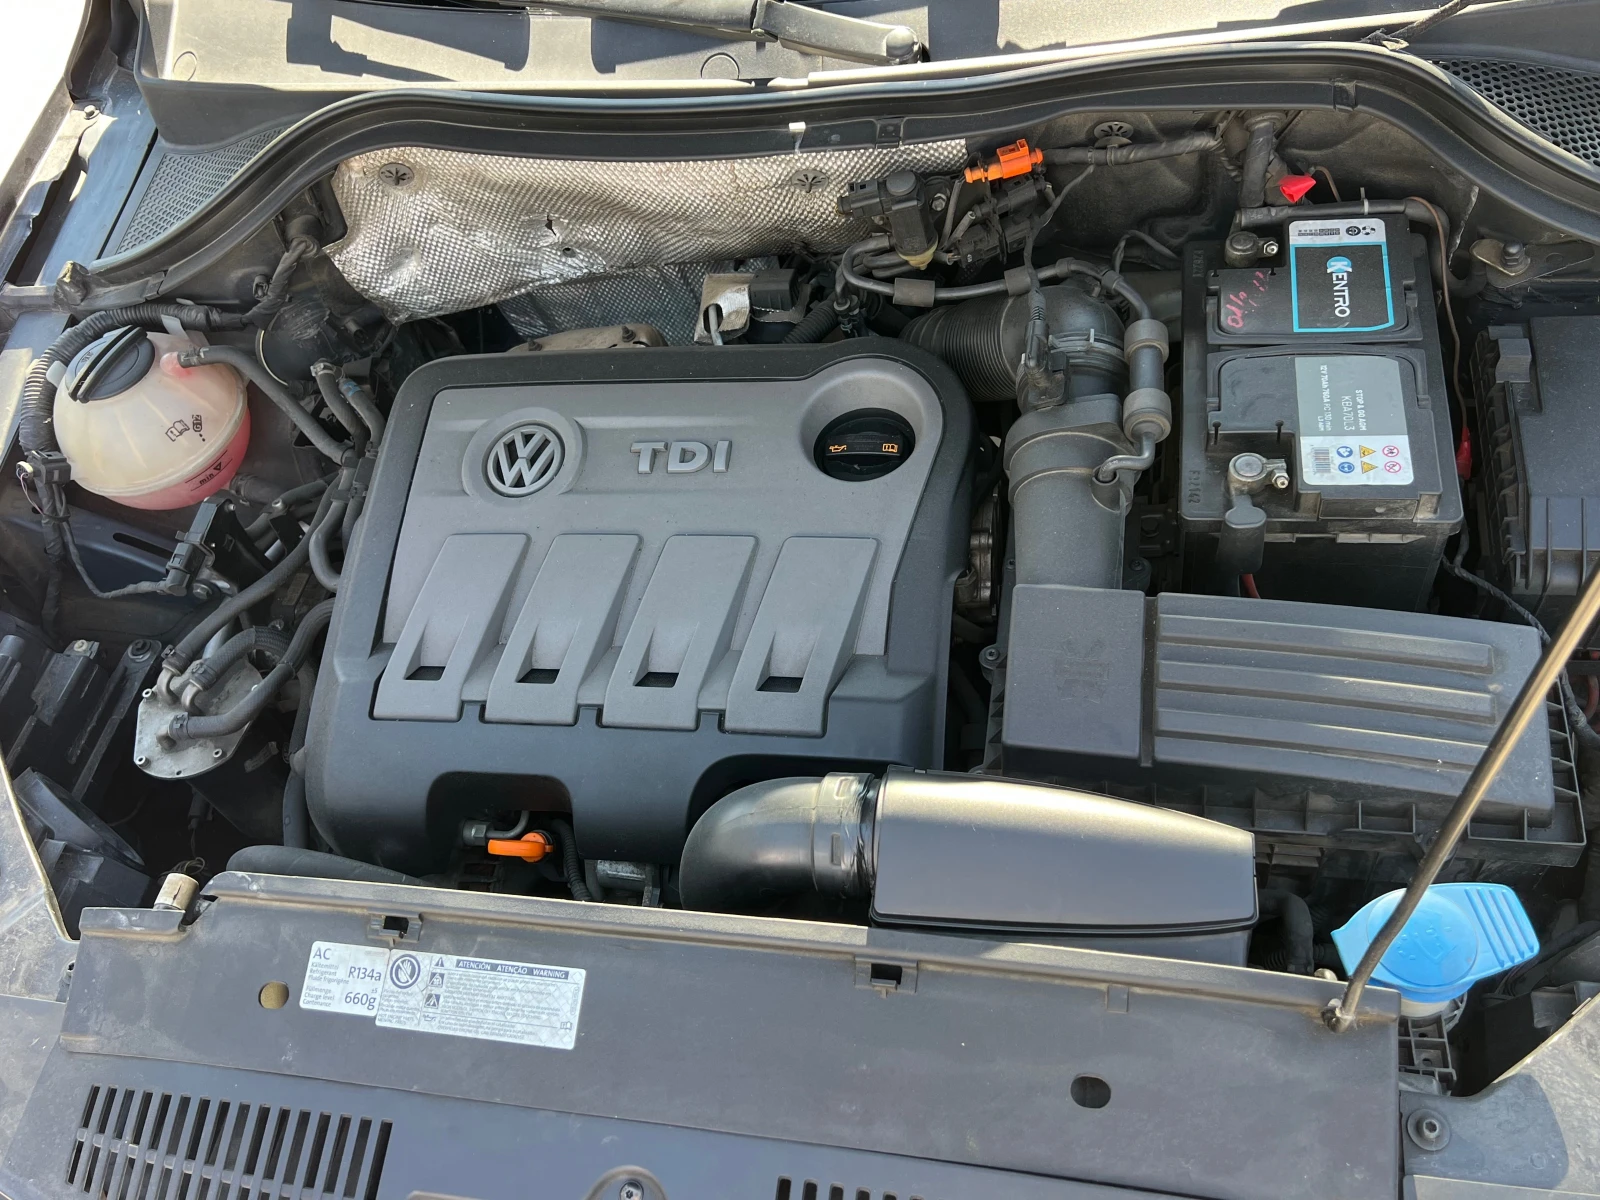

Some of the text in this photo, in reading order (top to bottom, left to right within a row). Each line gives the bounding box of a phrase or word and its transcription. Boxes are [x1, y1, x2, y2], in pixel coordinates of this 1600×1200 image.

[1326, 260, 1353, 318] KENTRO
[1321, 375, 1329, 388] 70Ah
[1322, 388, 1330, 402] 760A
[1355, 389, 1364, 405] STOP
[1341, 395, 1355, 431] KBA70L3
[1358, 409, 1365, 418] GO
[1325, 420, 1333, 431] min
[1359, 418, 1367, 431] AGM
[629, 439, 731, 475] TDI
[199, 472, 215, 485] min
[313, 947, 332, 961] AC
[309, 968, 337, 977] Refrigerant
[348, 966, 382, 982] R134a
[458, 959, 566, 979] ATENCIÓN ATENÇÃO WARNING
[302, 998, 332, 1008] Contenance
[304, 992, 322, 1001] Charge
[344, 991, 377, 1011] 660g
